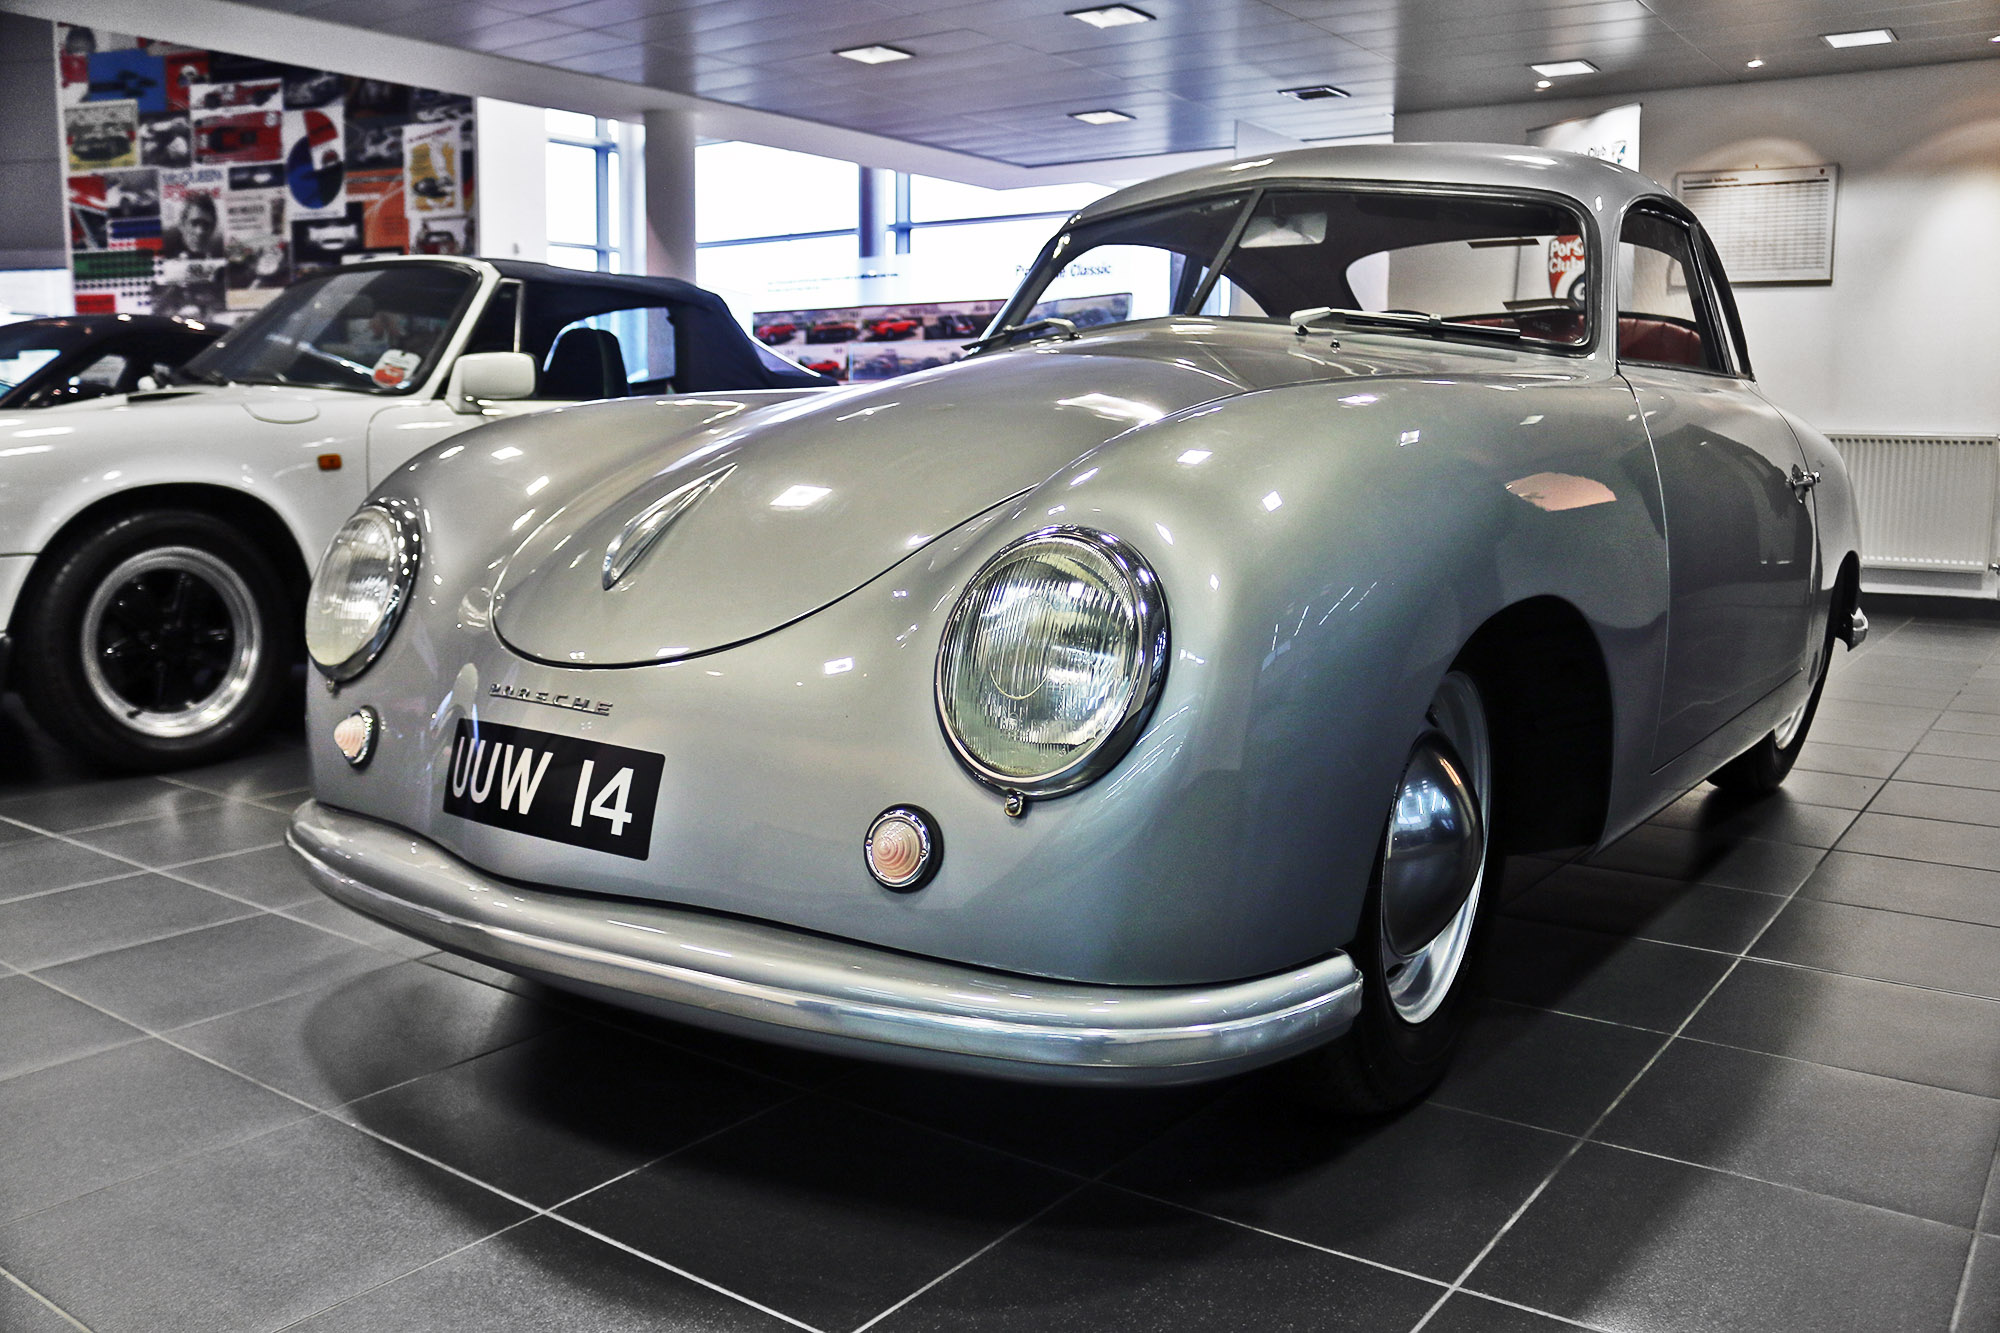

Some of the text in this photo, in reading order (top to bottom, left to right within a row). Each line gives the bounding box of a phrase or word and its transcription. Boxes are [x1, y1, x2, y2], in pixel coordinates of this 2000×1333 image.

[489, 683, 614, 716] PORSCHE
[452, 736, 634, 836] UUW 14
